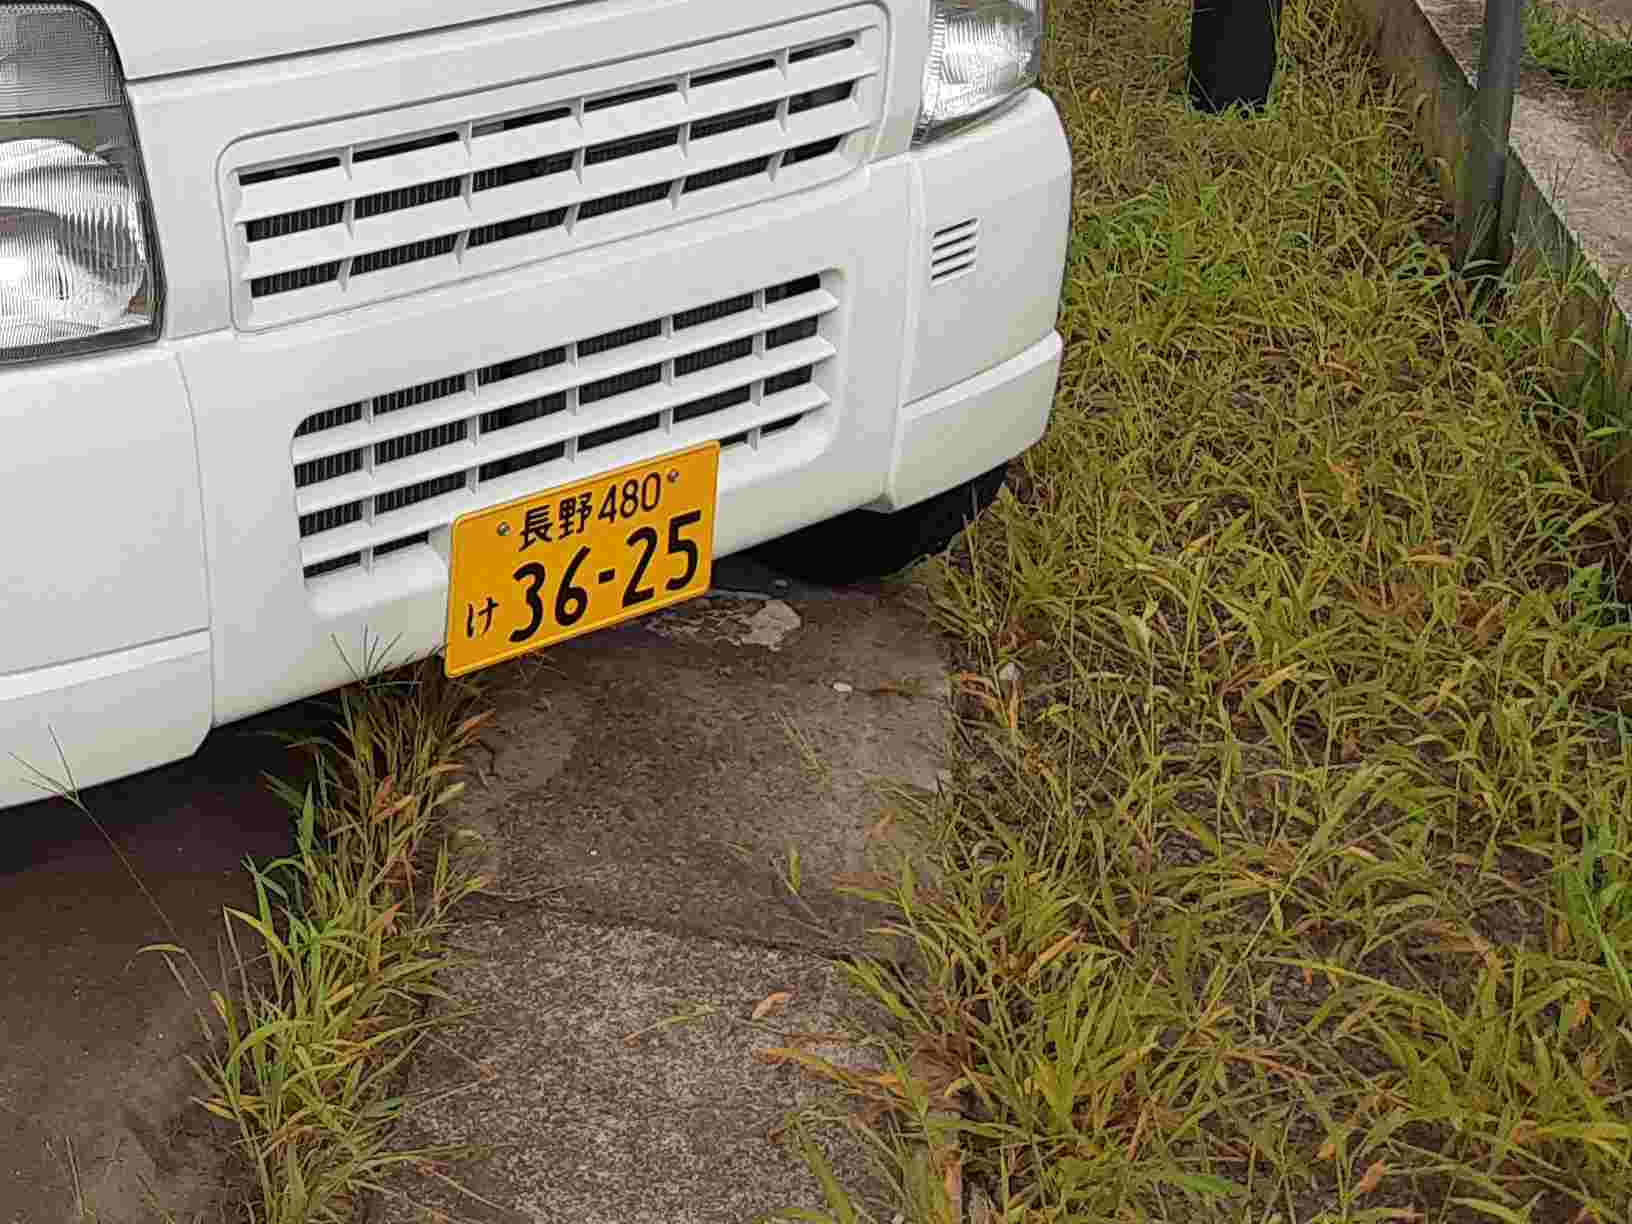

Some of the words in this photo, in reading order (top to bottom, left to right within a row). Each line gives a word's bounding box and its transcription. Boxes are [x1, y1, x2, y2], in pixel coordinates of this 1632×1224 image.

[518, 491, 593, 552] 長野
[598, 471, 662, 523] 480
[466, 597, 499, 638] け
[509, 509, 702, 642] 36-25
